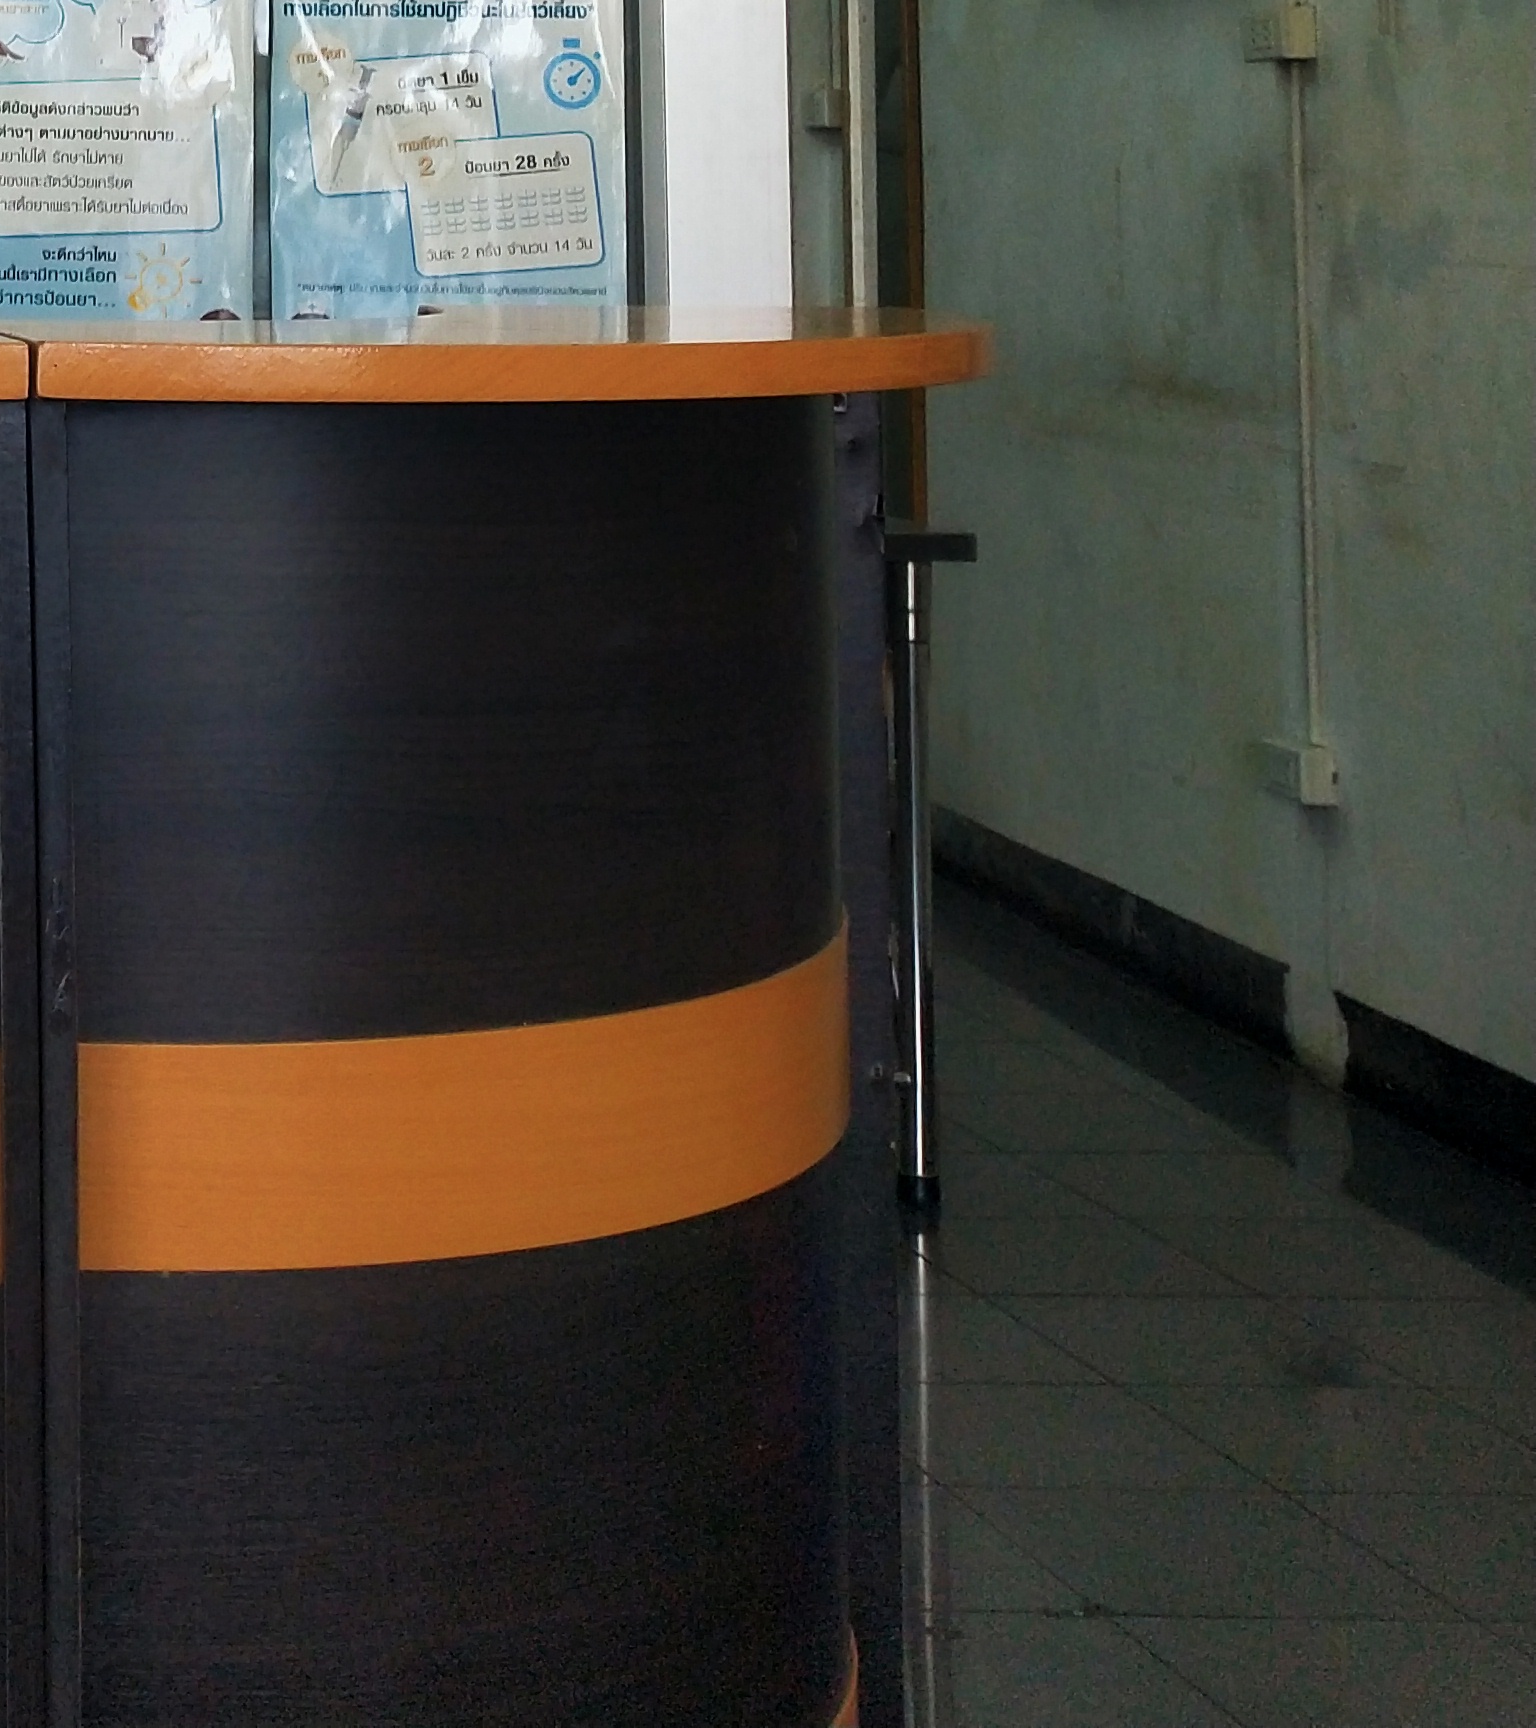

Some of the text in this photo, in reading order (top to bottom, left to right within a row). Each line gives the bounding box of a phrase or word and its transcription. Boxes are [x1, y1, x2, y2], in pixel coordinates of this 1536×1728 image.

[441, 73, 449, 87] 1
[465, 95, 483, 110] วัน
[419, 156, 436, 177] 2
[464, 150, 570, 175] ป้อนยา 28 ครั้ง
[41, 246, 117, 263] จะดีกว่าไหม
[426, 246, 456, 262] วันละ
[461, 247, 470, 260] 2
[507, 241, 548, 257] จำนวน
[554, 239, 570, 252] 14
[575, 237, 594, 253] วัน
